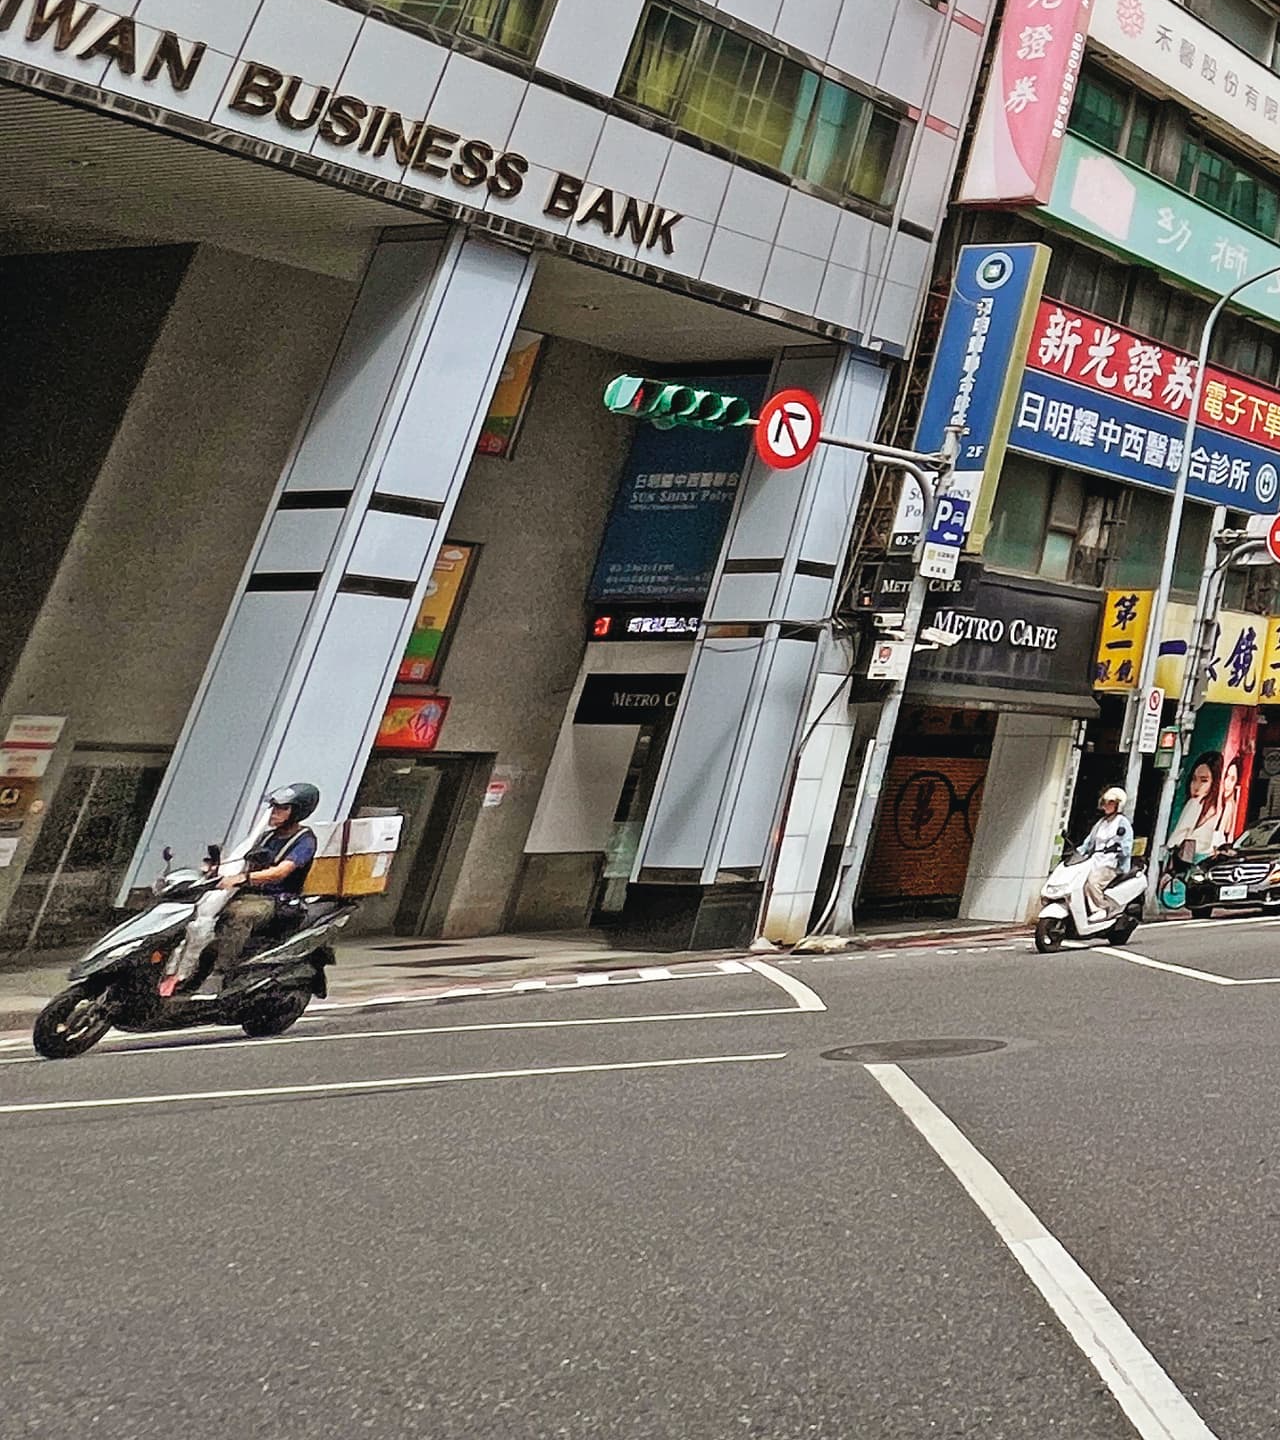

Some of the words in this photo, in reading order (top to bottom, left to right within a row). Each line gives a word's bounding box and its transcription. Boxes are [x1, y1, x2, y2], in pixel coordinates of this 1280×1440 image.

[228, 60, 530, 200] BUSINESS
[542, 171, 687, 255] BANK
[1037, 307, 1199, 411] 新光證券
[966, 446, 985, 458] 2F
[932, 499, 953, 531] P
[933, 611, 1004, 643] METRO
[1009, 619, 1059, 650] CAFE
